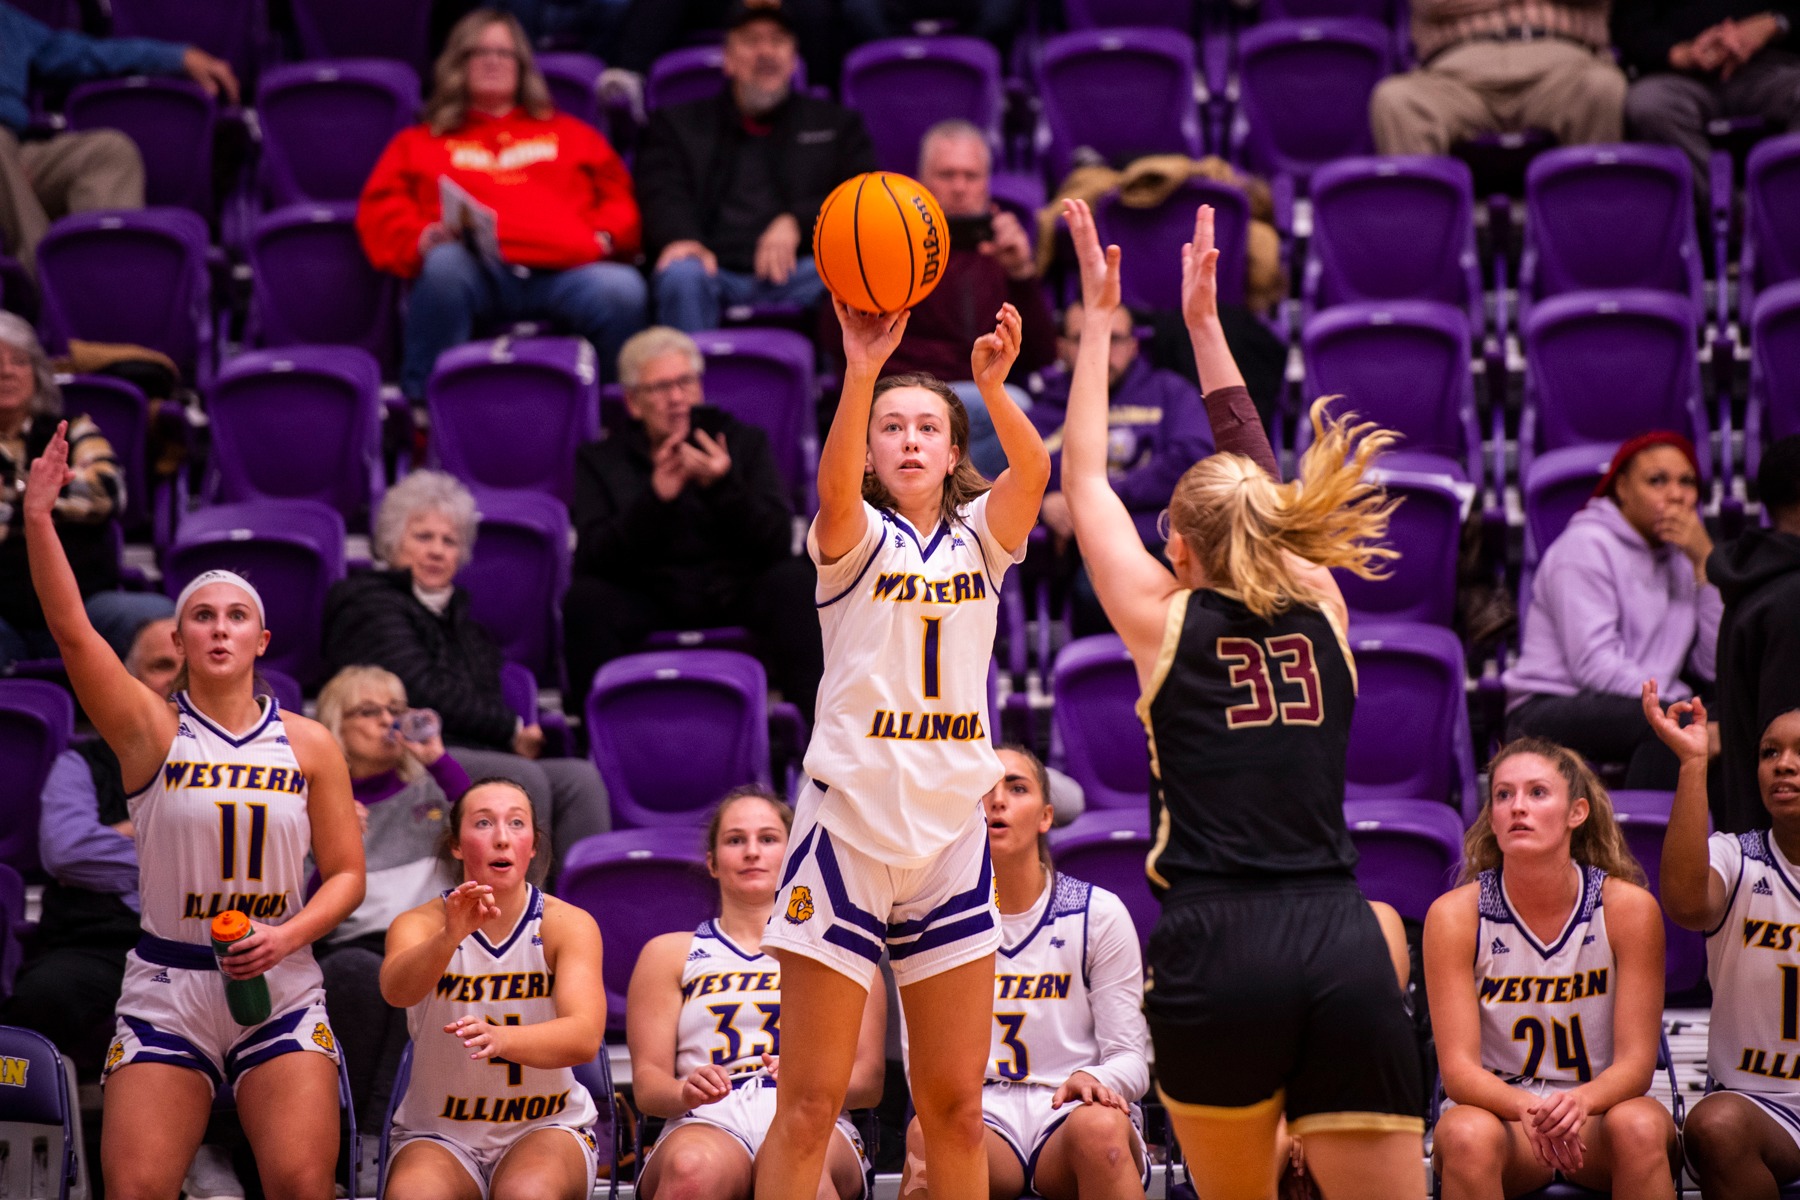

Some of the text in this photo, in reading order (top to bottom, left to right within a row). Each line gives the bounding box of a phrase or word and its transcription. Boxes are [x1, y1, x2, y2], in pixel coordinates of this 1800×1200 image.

[912, 196, 940, 288] Wilson
[872, 572, 985, 604] WSTERN
[920, 615, 942, 700] 1
[1216, 632, 1324, 729] 33
[163, 761, 305, 794] WESTERN
[214, 801, 268, 882] 11
[1744, 917, 1800, 951] WES
[682, 972, 780, 1002] WESTE
[995, 972, 1072, 1000] TERN
[1480, 967, 1609, 1004] WESTERN
[706, 1002, 780, 1065] 33
[993, 1012, 1030, 1082] 3
[1512, 1012, 1592, 1081] 24
[437, 1088, 571, 1124] ILLINOIS
